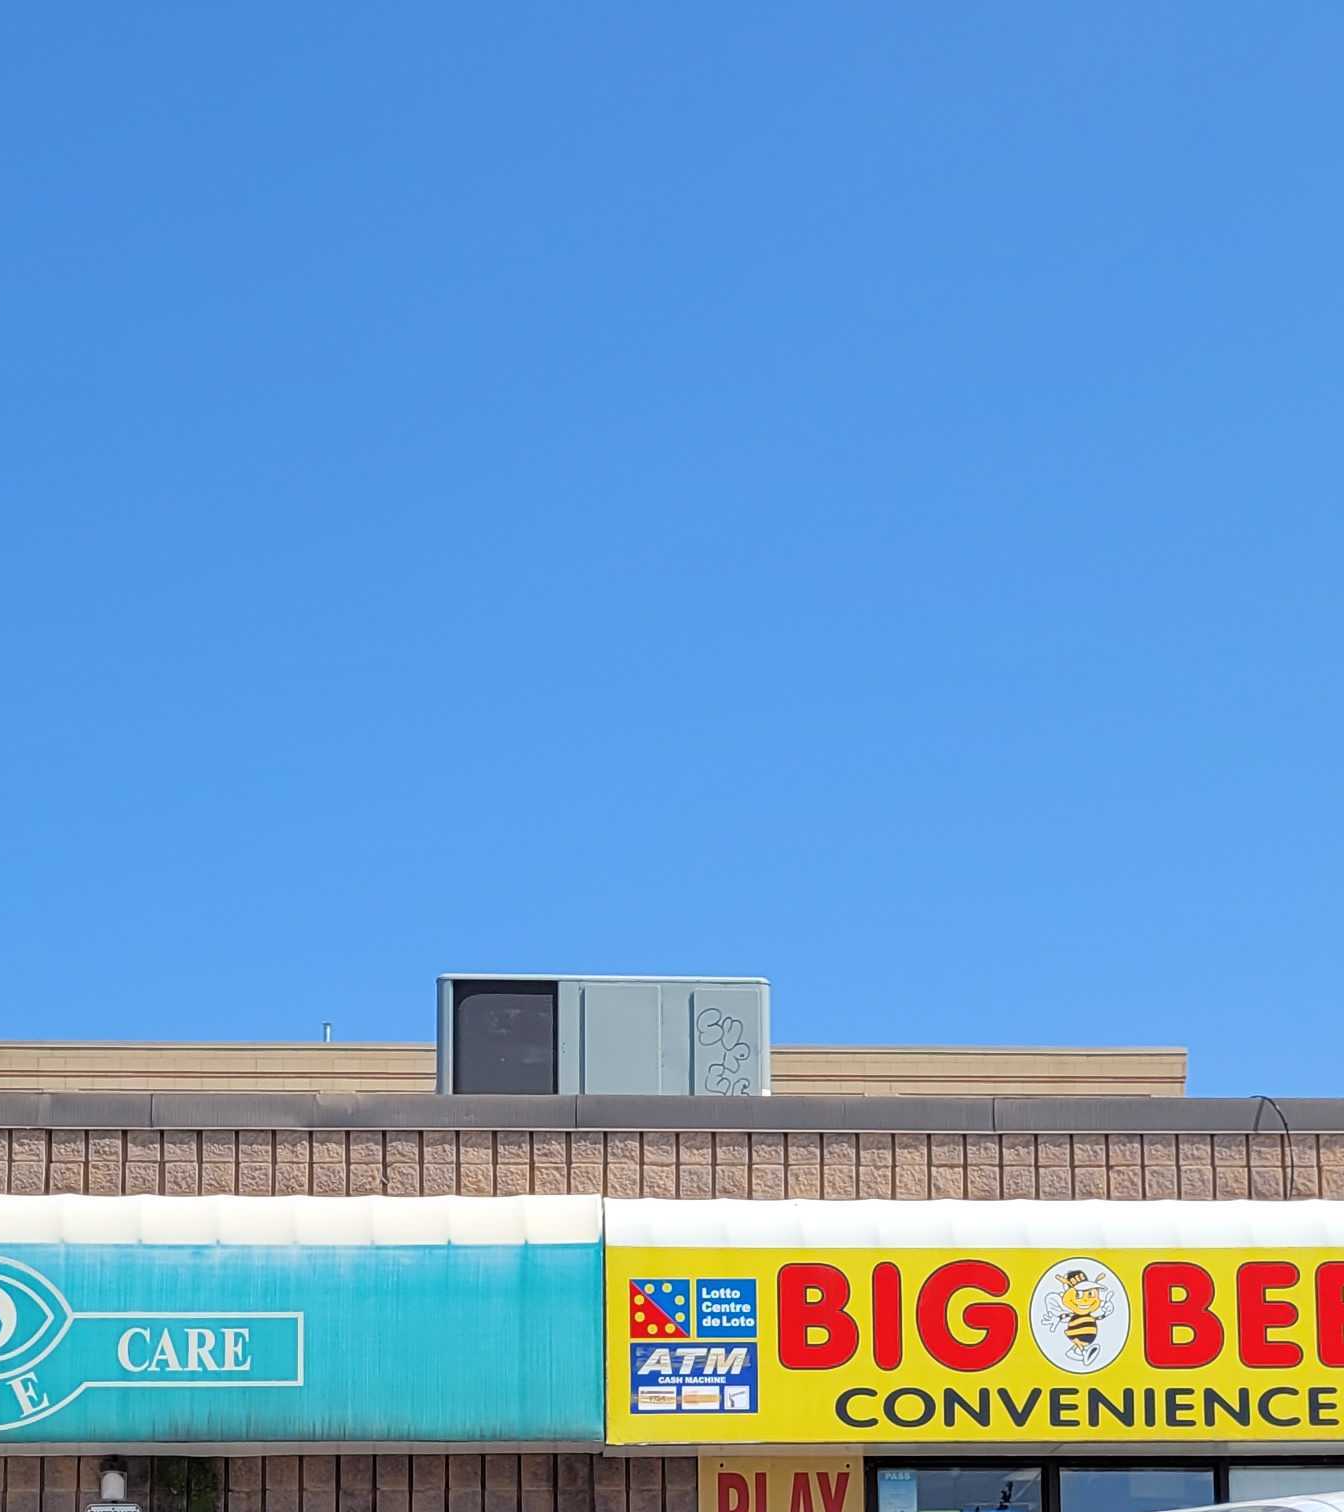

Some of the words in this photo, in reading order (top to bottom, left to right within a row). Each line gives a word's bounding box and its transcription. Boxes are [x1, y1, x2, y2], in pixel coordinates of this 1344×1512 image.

[701, 1287, 740, 1299] Lotto
[701, 1301, 752, 1313] Centre
[777, 1260, 1018, 1371] BIG
[702, 1315, 722, 1327] de
[722, 1315, 756, 1327] Loto
[117, 1327, 251, 1372] CARE
[637, 1347, 749, 1375] ATM
[658, 1376, 683, 1384] CASH
[685, 1376, 727, 1384] MACHINE
[835, 1386, 1340, 1428] CONVENIENCE
